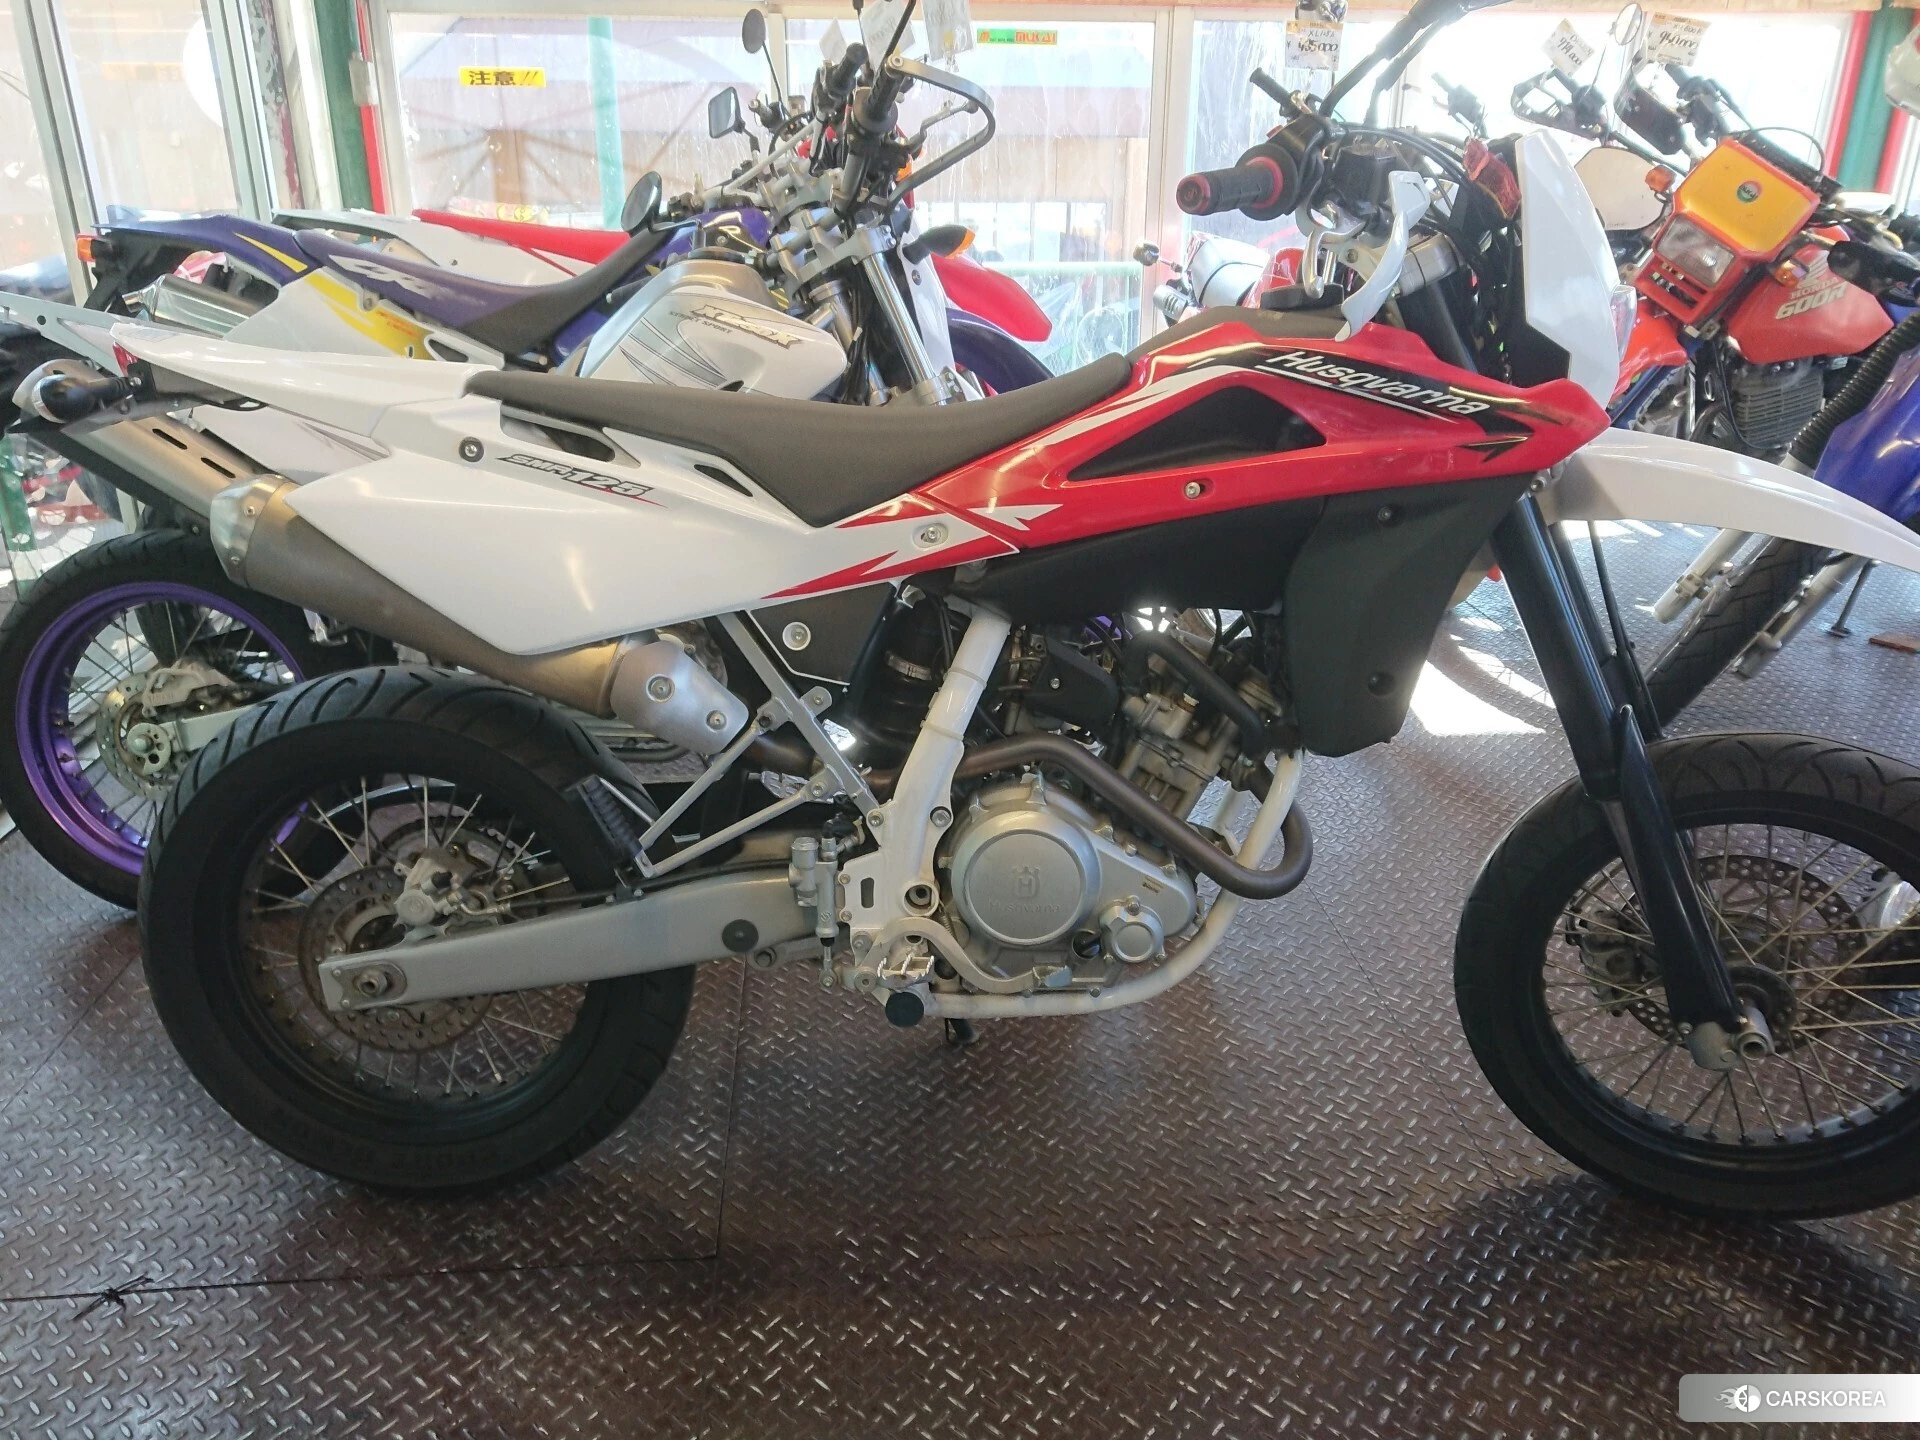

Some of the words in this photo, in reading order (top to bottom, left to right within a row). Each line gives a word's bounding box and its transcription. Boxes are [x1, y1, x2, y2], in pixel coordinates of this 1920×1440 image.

[1775, 280, 1850, 320] 600R
[1792, 277, 1840, 299] HONDA
[702, 320, 733, 334] SPORT
[1266, 351, 1491, 415] Husqvarna
